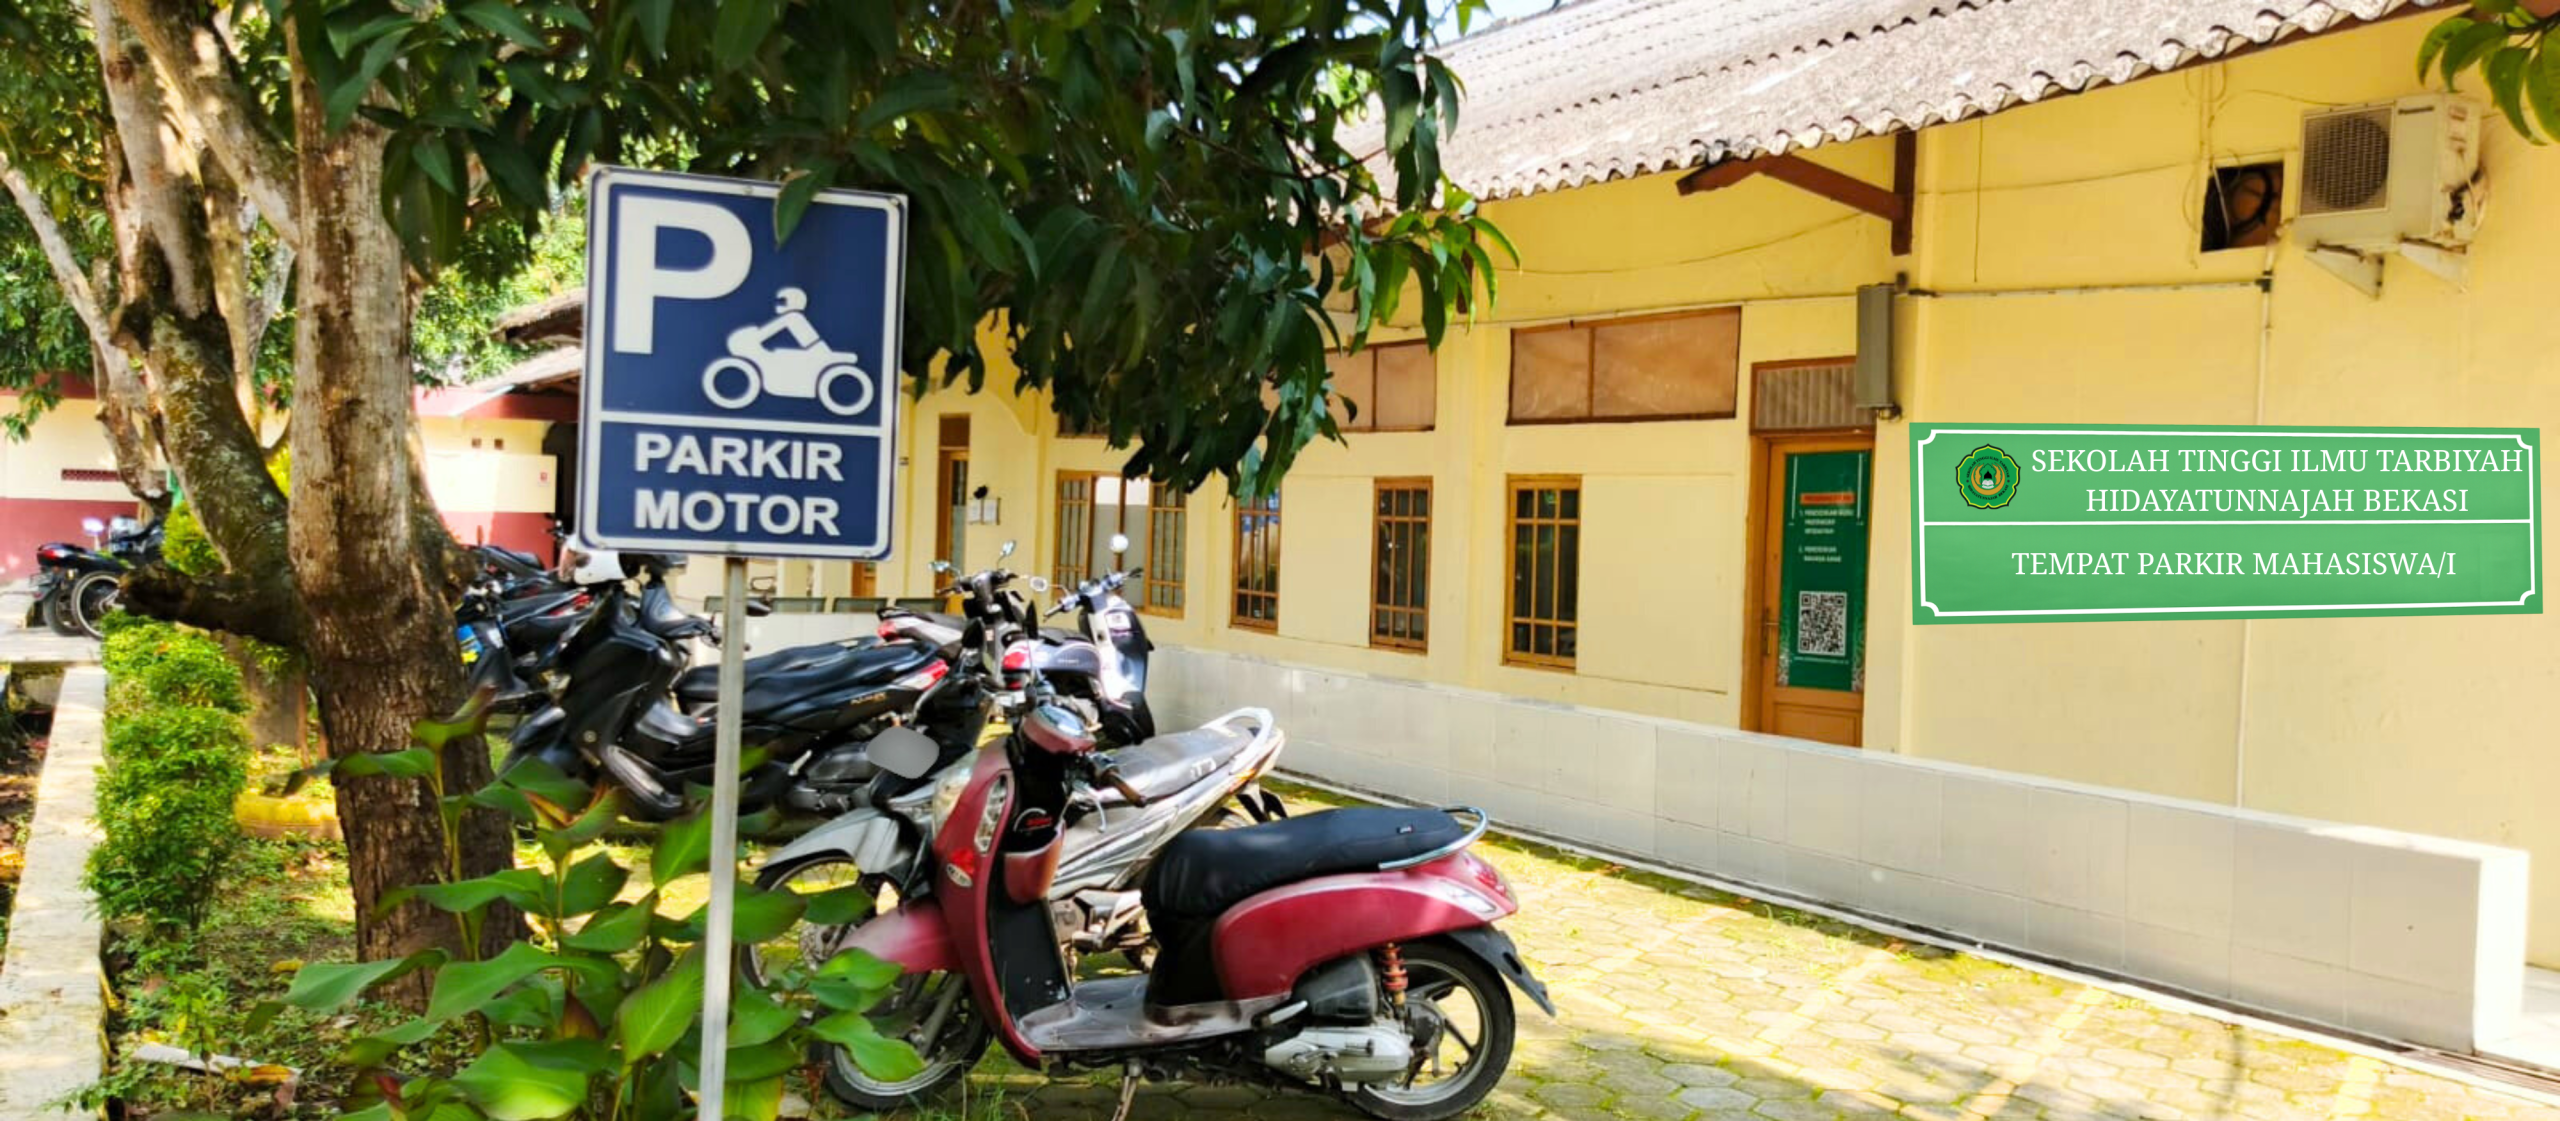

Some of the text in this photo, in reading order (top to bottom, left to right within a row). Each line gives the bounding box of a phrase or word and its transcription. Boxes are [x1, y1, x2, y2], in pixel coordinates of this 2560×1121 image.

[614, 195, 752, 355] P
[635, 432, 843, 482] PARKIR
[2031, 449, 2524, 473] SEKOLAH TINGGI ILMU TARBIYAH
[634, 489, 840, 536] MOTOR
[2085, 488, 2469, 519] HIDAYATUNNAJAH BEKASI
[2011, 551, 2457, 579] TEMPAT PARKIR MAHASISWA/I
